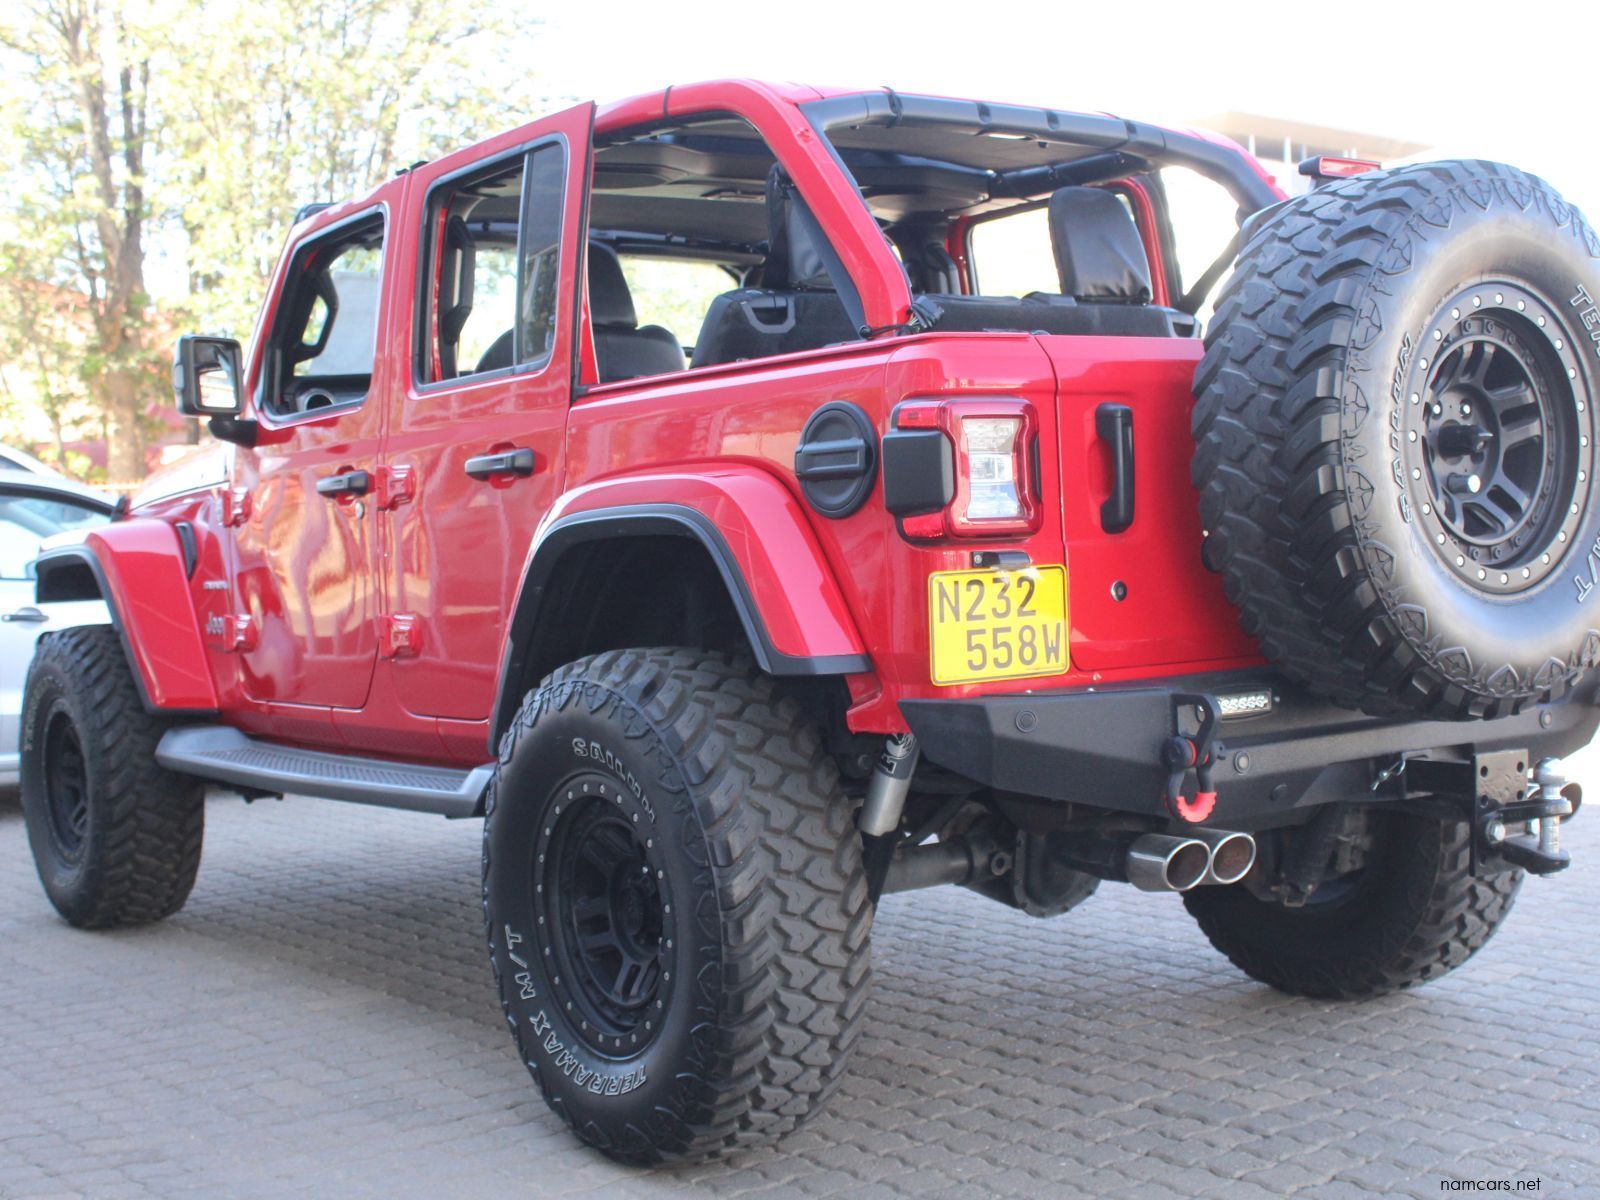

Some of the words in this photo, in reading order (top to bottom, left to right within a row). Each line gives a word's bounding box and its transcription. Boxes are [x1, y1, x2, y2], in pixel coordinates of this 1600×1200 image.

[938, 576, 1036, 623] N232
[966, 622, 1061, 671] 558W
[504, 924, 536, 1000] M/T
[529, 1010, 647, 1096] TERRAMAX
